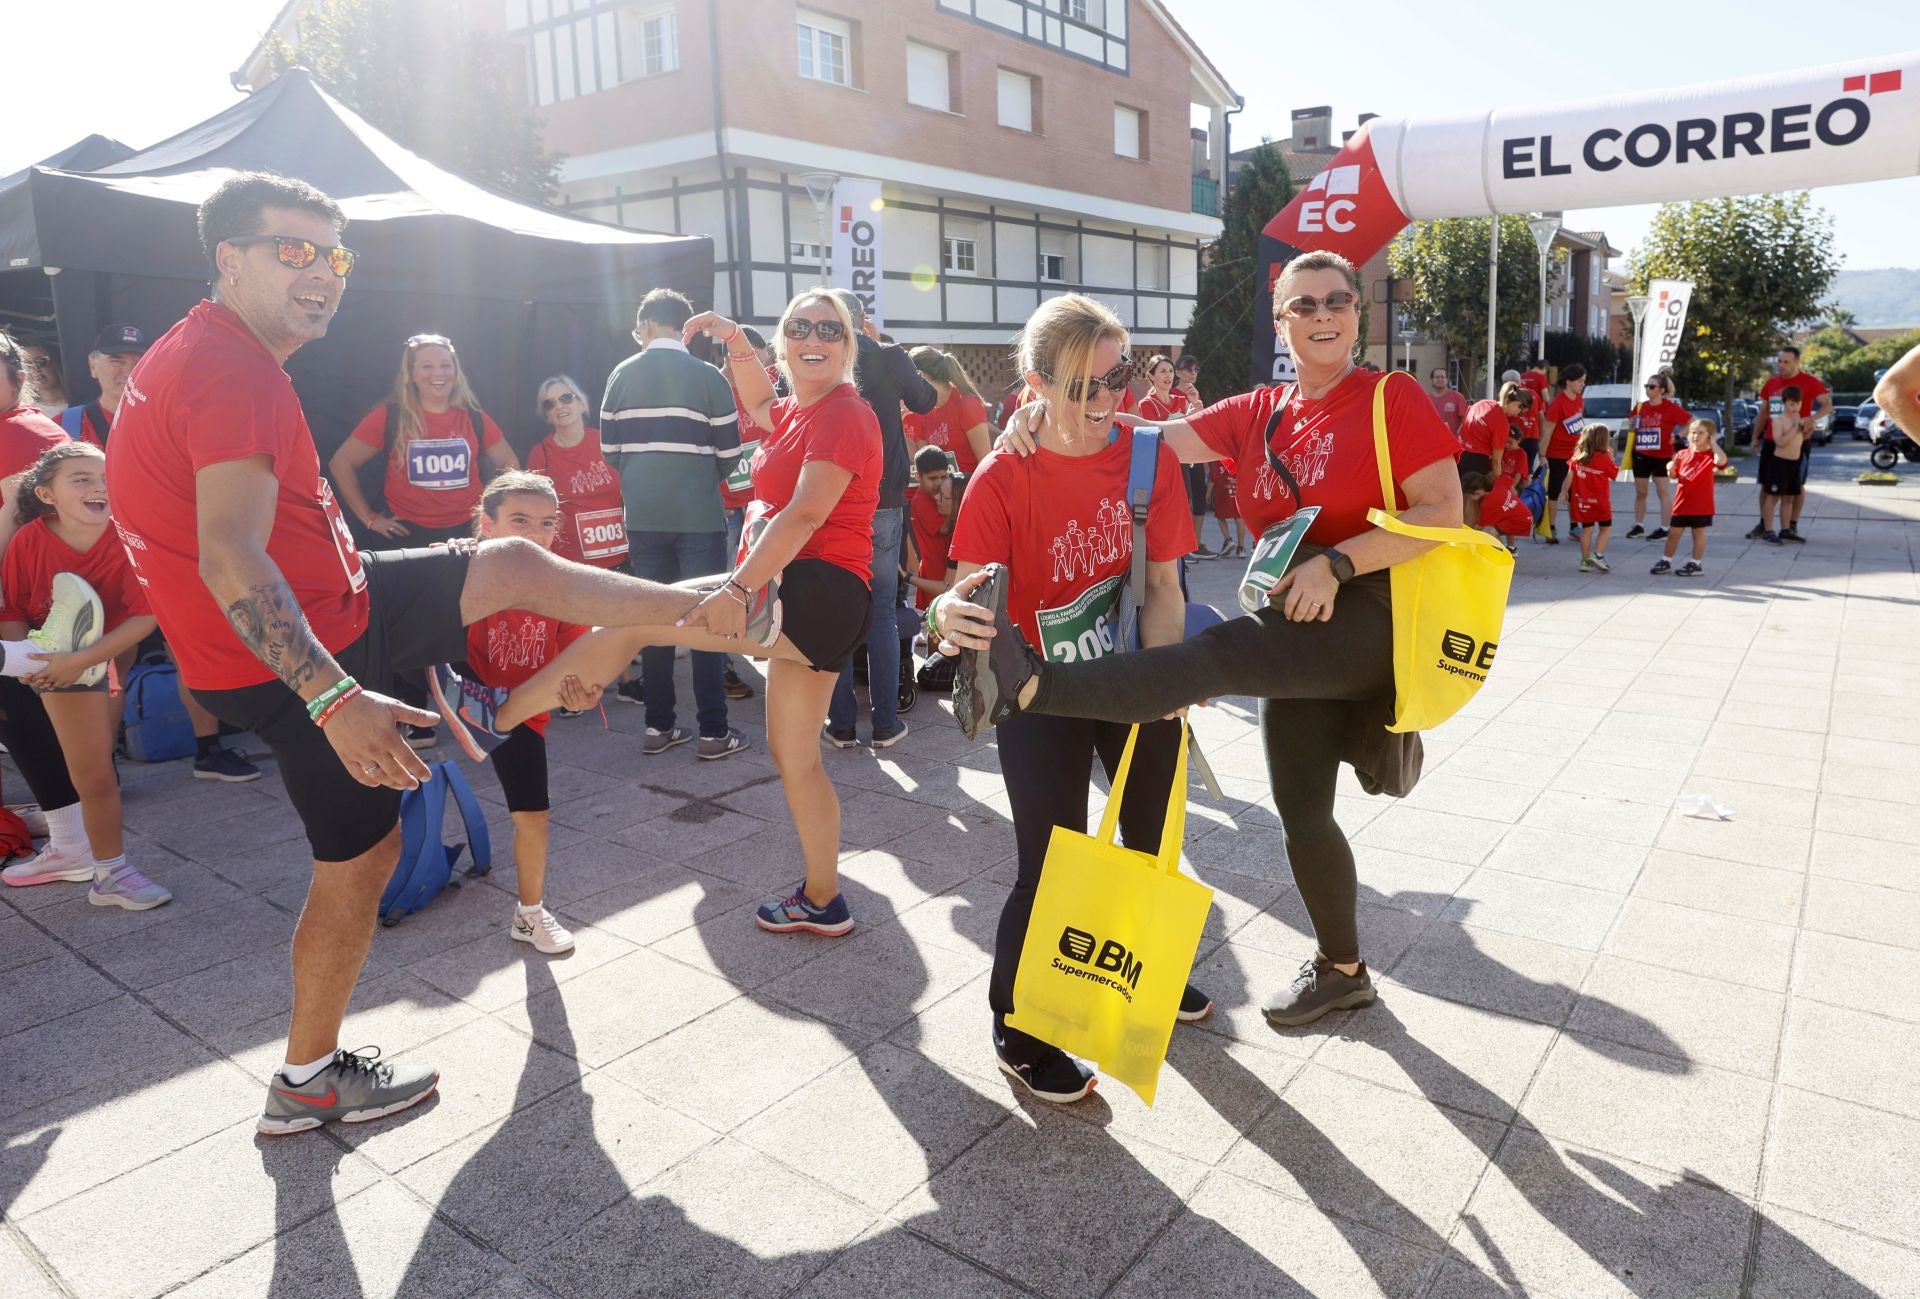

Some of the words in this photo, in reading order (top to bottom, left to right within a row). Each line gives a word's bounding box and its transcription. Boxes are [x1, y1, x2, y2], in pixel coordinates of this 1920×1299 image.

[1503, 135, 1572, 179] EL
[1583, 98, 1871, 172] CORREO
[1298, 200, 1357, 233] EC
[1637, 434, 1658, 444] 1007
[412, 453, 466, 474] 1004
[583, 522, 624, 544] 3003
[1436, 658, 1486, 682] Superme
[1094, 939, 1143, 990] BM
[1051, 957, 1132, 1004] Supermercados
